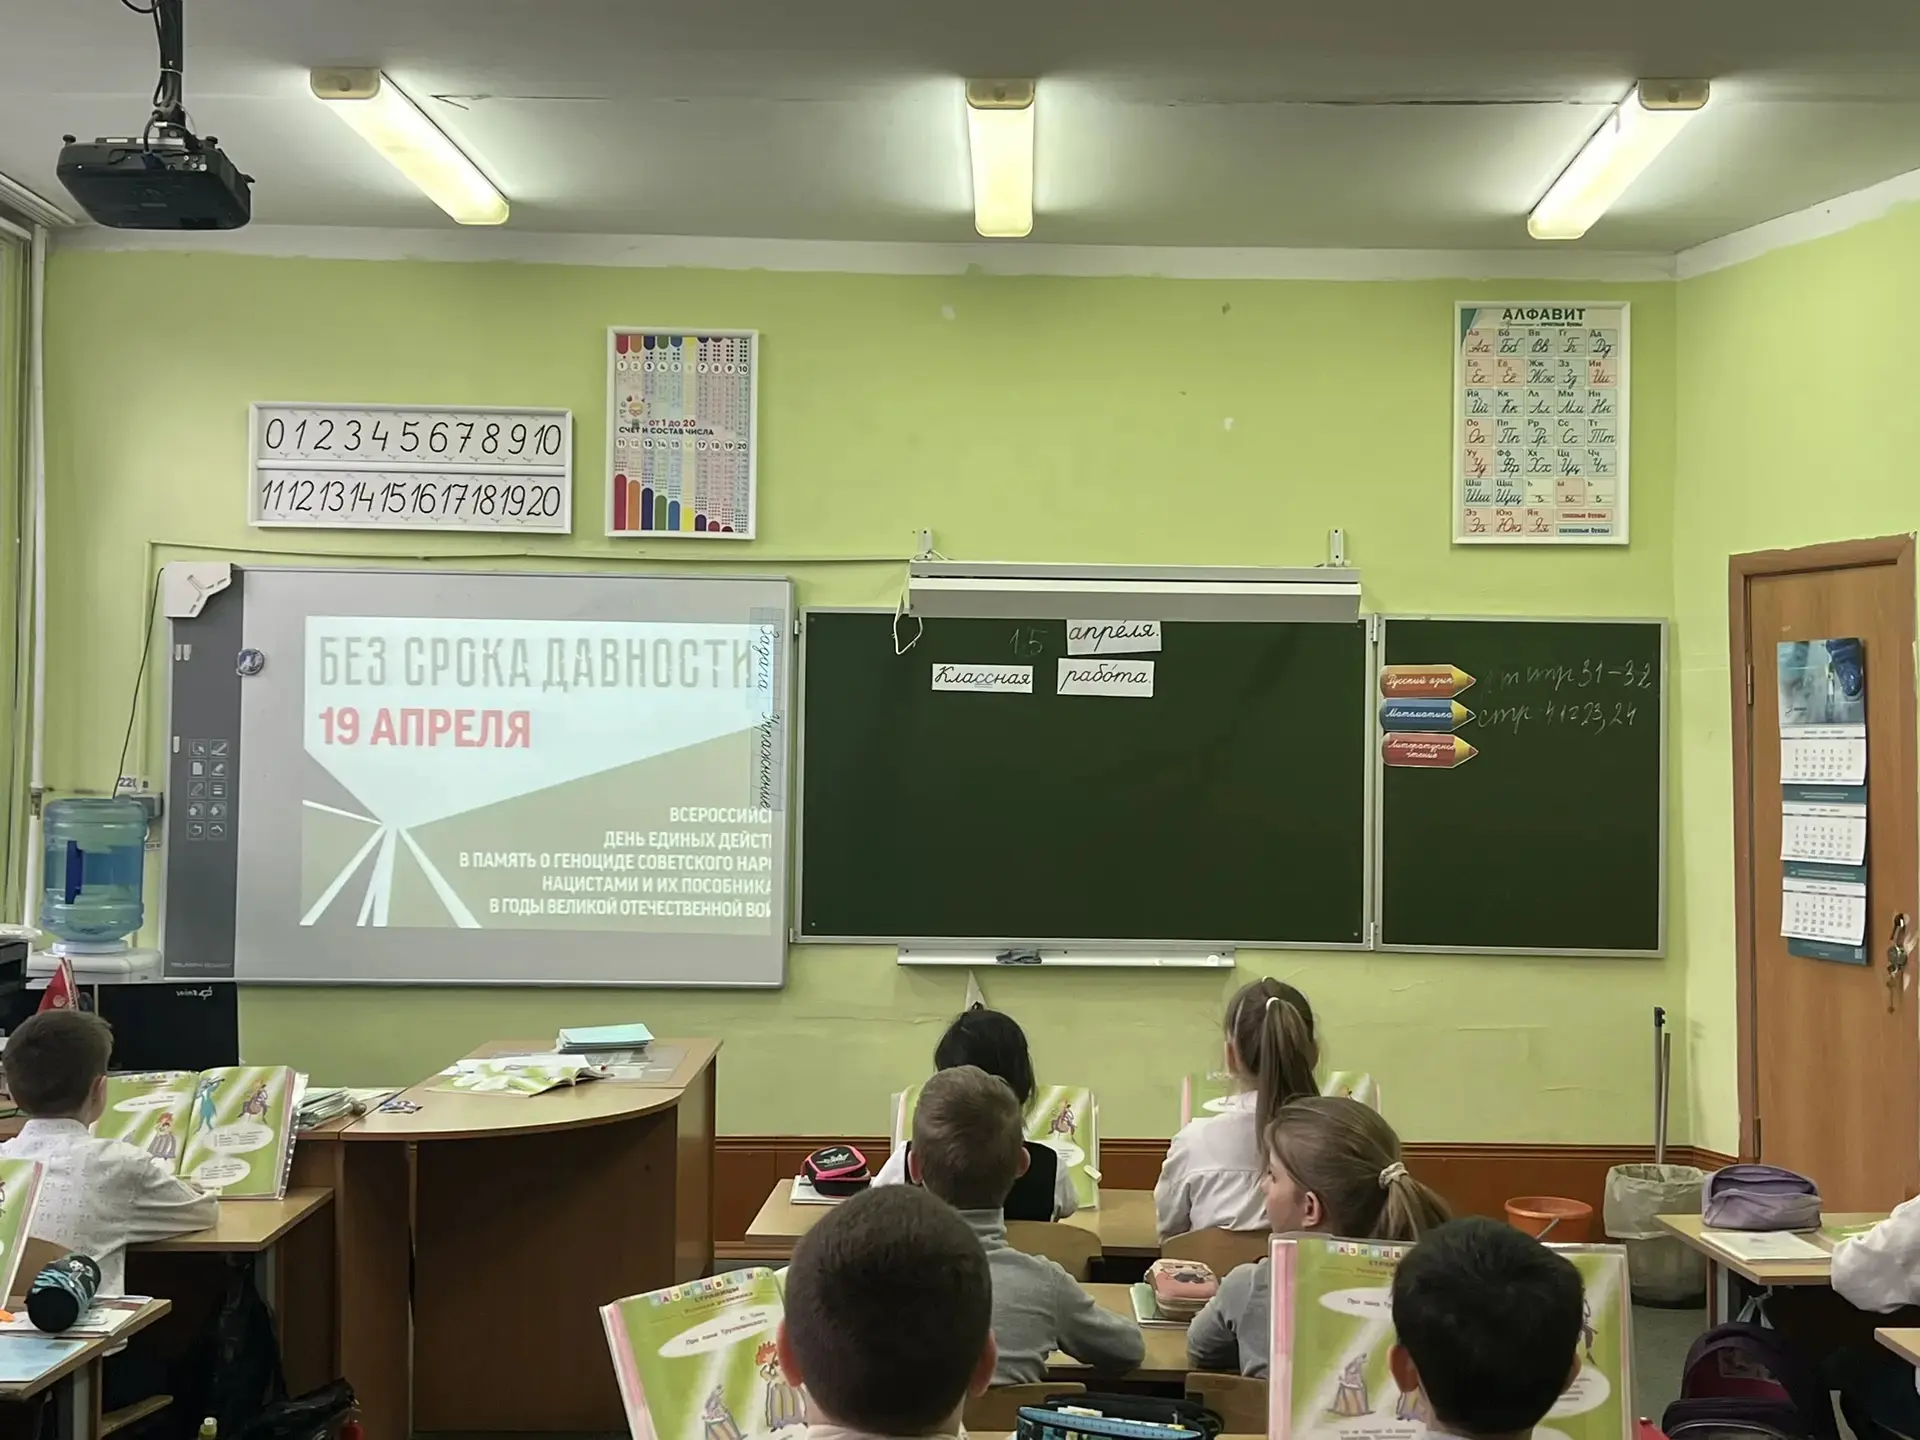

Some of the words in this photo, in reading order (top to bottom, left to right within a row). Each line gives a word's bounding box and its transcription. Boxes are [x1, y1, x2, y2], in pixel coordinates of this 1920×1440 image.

[1502, 308, 1586, 320] АЛФАВИТ
[266, 418, 284, 449] 0
[295, 419, 307, 449] 1
[313, 419, 334, 450] 2
[344, 420, 361, 451] 3
[371, 420, 389, 452] 4
[400, 421, 419, 452] 5
[429, 422, 449, 453] 6
[456, 422, 474, 453] 7
[482, 423, 500, 454] 8
[508, 424, 527, 454] 9
[534, 424, 561, 455] 10
[262, 480, 284, 510] 11
[288, 480, 314, 511] 12
[320, 481, 345, 512] 13
[350, 482, 374, 512] 14
[380, 482, 407, 513] 15
[411, 483, 437, 514] 16
[441, 484, 469, 514] 17
[472, 484, 497, 515] 18
[501, 485, 526, 516] 19
[527, 485, 561, 516] 20
[1009, 628, 1048, 654] 15
[320, 636, 386, 686] БЕЗ
[404, 637, 531, 687] СРОКА
[542, 637, 752, 693] ДАВНОСТИ
[752, 625, 780, 692] Задача
[934, 665, 1031, 687] Классная
[1386, 674, 1426, 689] Русский
[1429, 677, 1454, 688] язык
[1385, 708, 1452, 718] Математика
[319, 707, 359, 745] 19
[370, 708, 530, 748] АПРЕЛЯ
[1388, 739, 1455, 752] Литературное
[754, 711, 780, 810] Упражнение
[603, 831, 646, 849] ДЕНЬ
[648, 831, 716, 850] ЕДИНЫХ
[718, 830, 772, 852] ДЕЙСТ
[459, 852, 469, 868] В
[473, 852, 536, 868] ПАМЯТЬ
[540, 853, 550, 868] О
[554, 853, 634, 872] ГЕНОЦИДЕ
[638, 854, 733, 871] СОВЕТСКОГО
[542, 875, 638, 895] НАЦИСТАМИ
[643, 877, 653, 892] И
[657, 877, 679, 893] ИХ
[489, 898, 499, 913] В
[502, 898, 544, 916] ГОДЫ
[547, 897, 617, 915] ВЕЛИКОЙ
[620, 898, 742, 917] ОТЕЧЕСТВЕННОЙ
